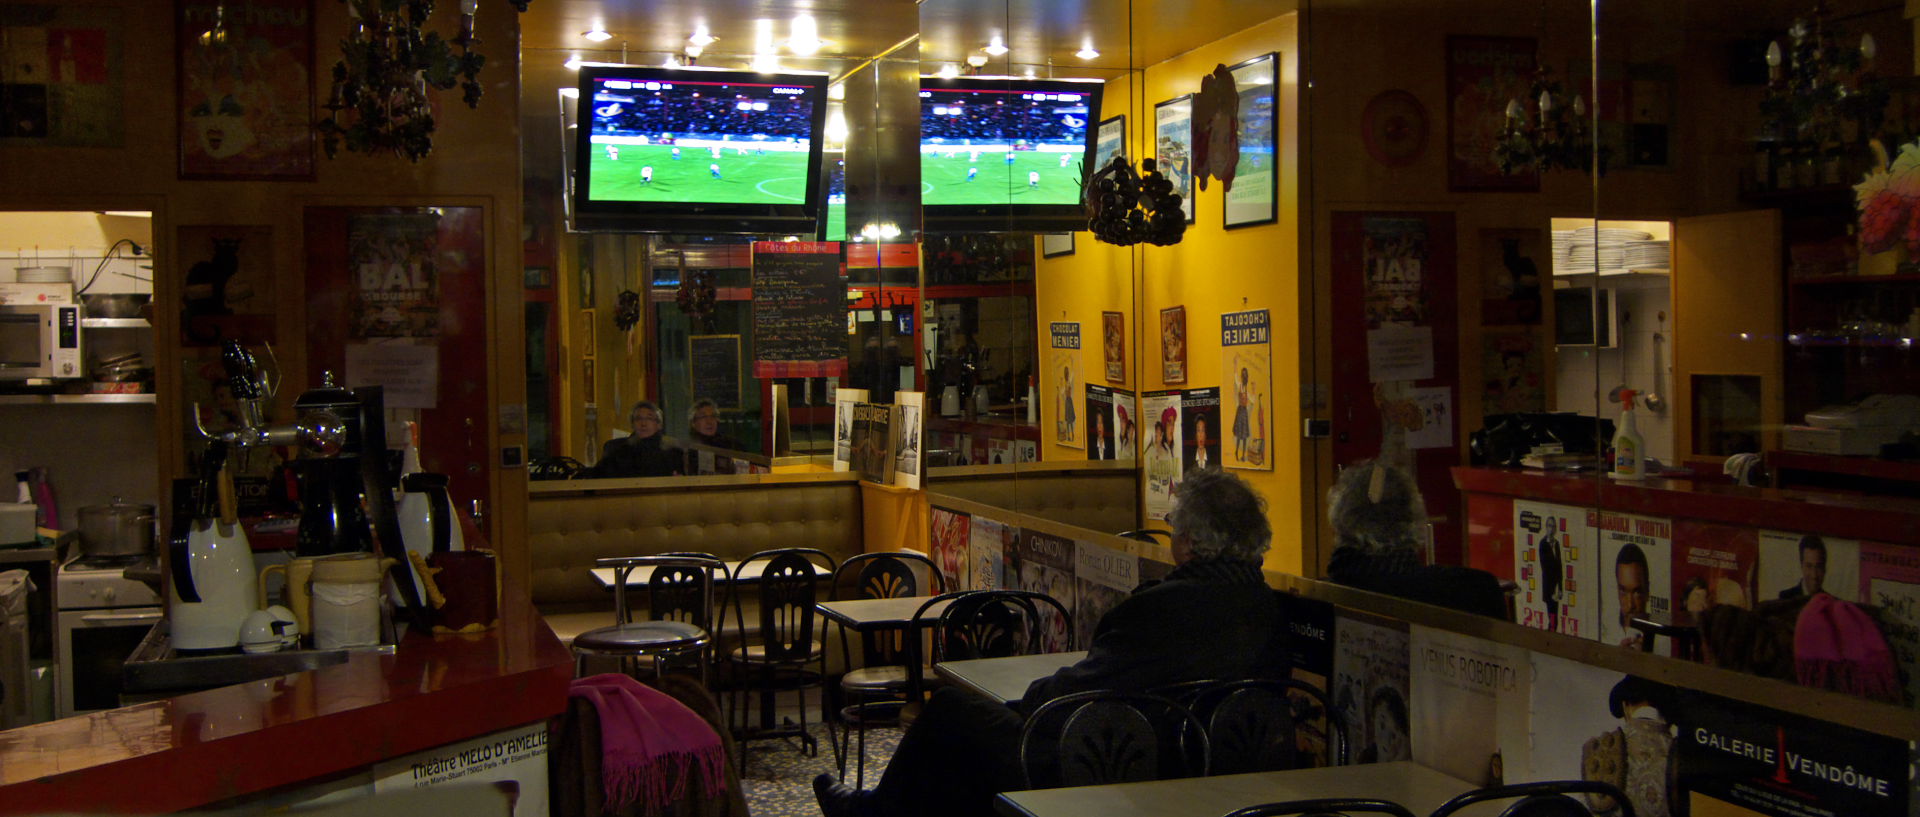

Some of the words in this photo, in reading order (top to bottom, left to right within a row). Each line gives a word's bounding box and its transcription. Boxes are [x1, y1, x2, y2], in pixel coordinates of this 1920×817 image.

[766, 242, 789, 252] Côtes
[792, 243, 801, 252] du
[803, 242, 827, 252] Rhône
[360, 263, 429, 289] BAL
[1052, 323, 1079, 334] CHOCOLAT
[1052, 335, 1079, 348] MENIER
[1289, 621, 1326, 641] ENDÔME
[1421, 647, 1456, 678] VENUS
[1460, 656, 1518, 693] ROBOTICA
[410, 757, 456, 779] Théâtre
[460, 744, 491, 767] MELO
[494, 730, 548, 758] D'AMELIE
[1695, 727, 1776, 765] GALERIE
[1784, 751, 1889, 797] VENDÔME
[430, 771, 466, 784] Marie-Stuart
[467, 765, 483, 777] 75002
[484, 761, 498, 771] Paris
